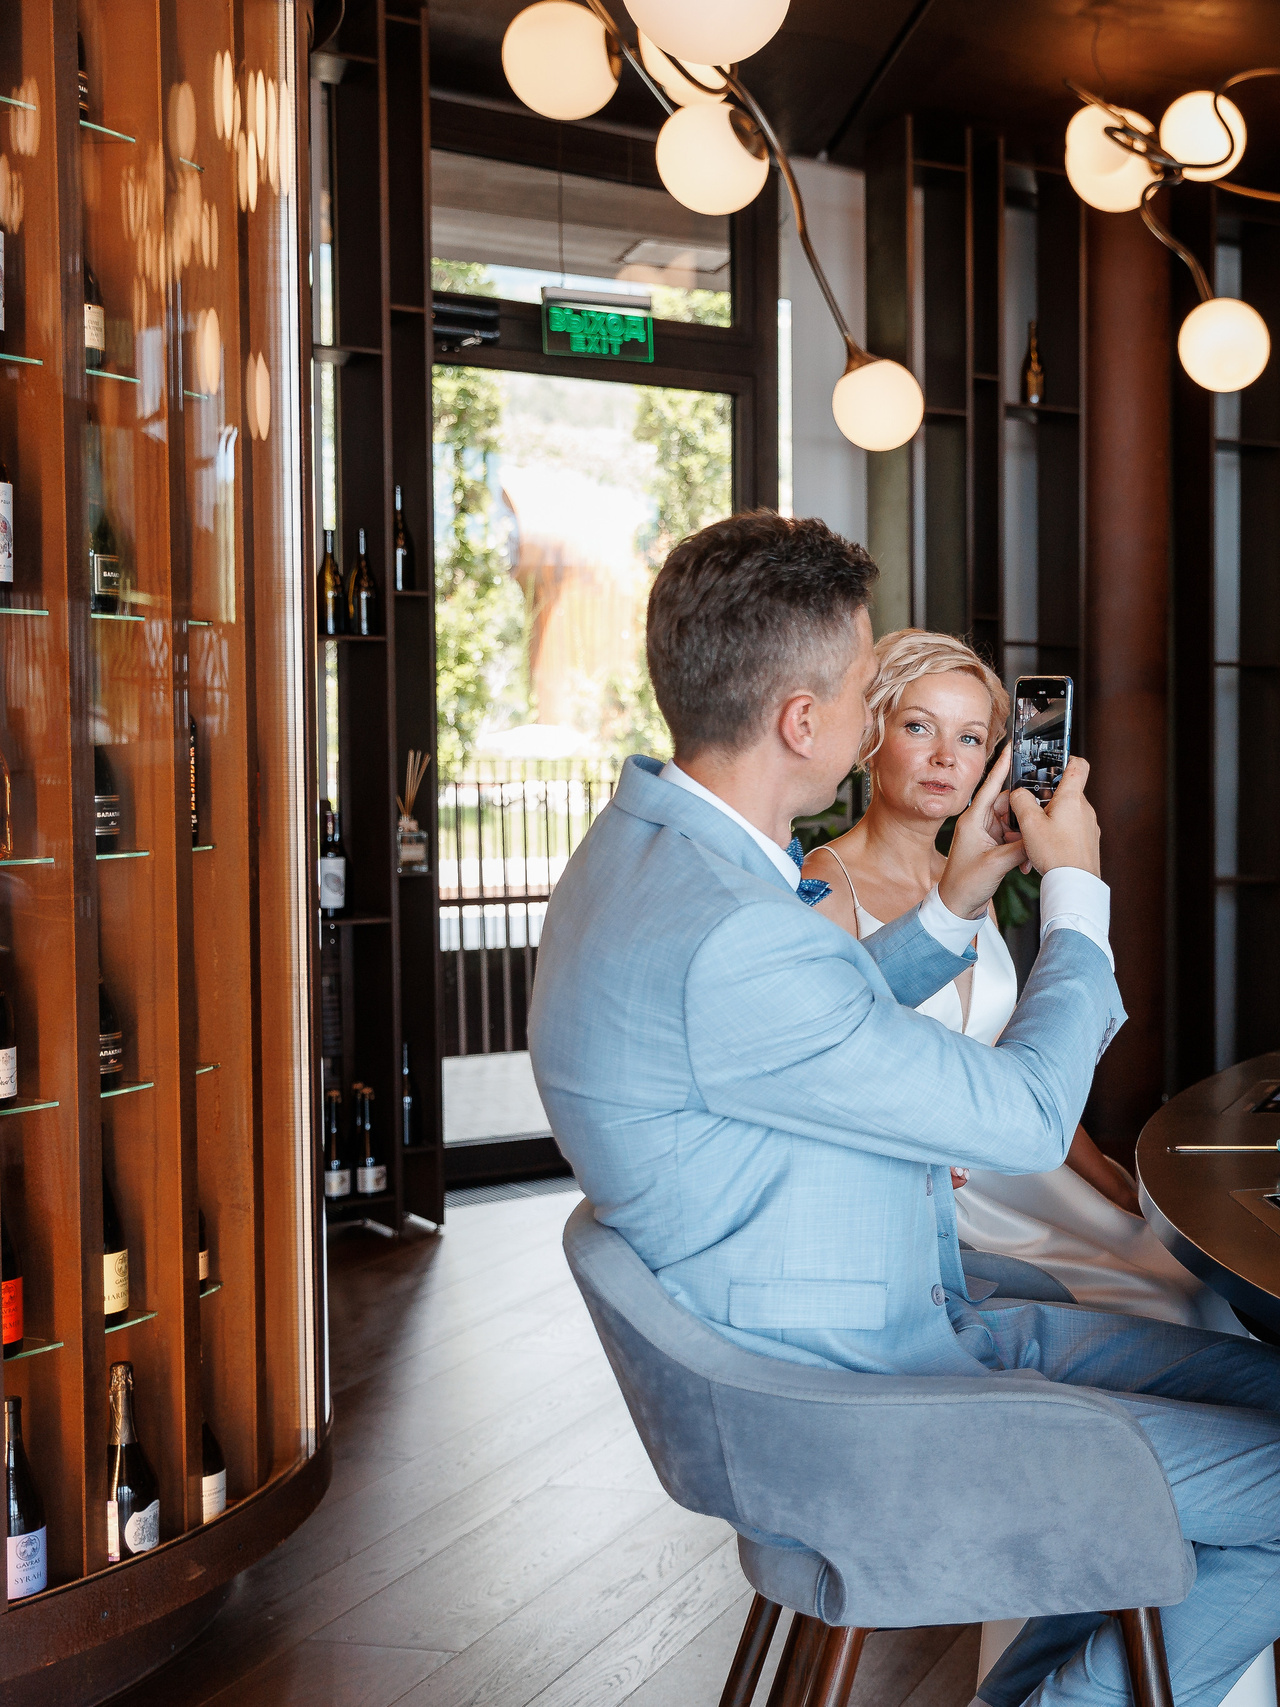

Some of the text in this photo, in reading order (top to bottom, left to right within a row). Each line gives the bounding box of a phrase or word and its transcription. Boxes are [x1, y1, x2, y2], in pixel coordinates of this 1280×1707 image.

[549, 306, 646, 343] ВЫХОД
[570, 333, 624, 355] EXIT
[14, 1571, 42, 1585] SYRAH
